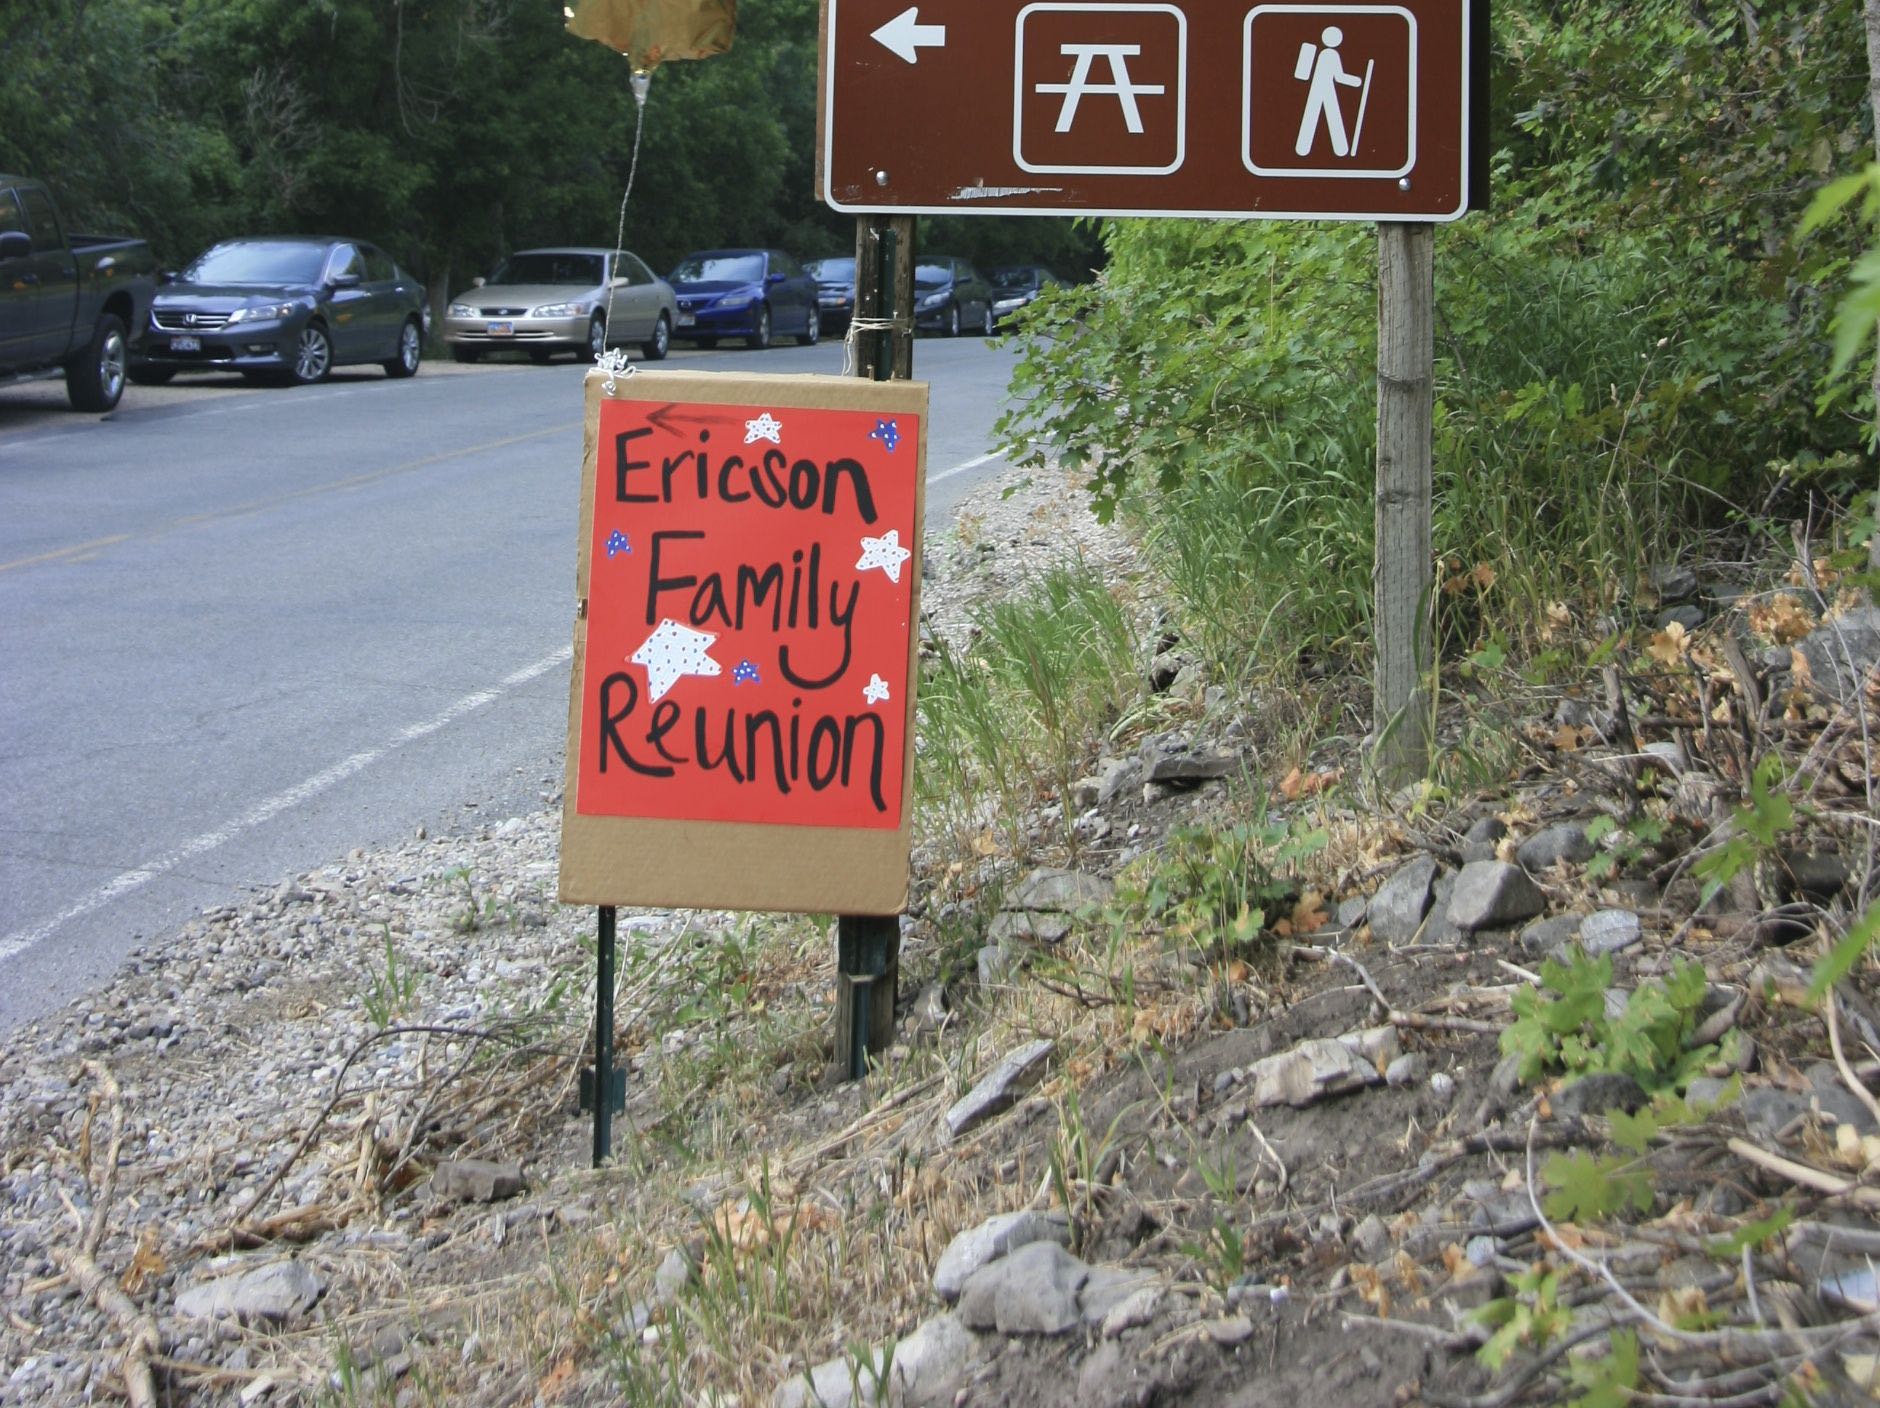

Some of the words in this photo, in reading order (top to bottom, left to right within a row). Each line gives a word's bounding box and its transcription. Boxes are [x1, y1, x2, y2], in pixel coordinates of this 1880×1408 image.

[615, 427, 878, 525] Ericson
[646, 530, 860, 690] Family
[599, 672, 887, 812] Reunion
